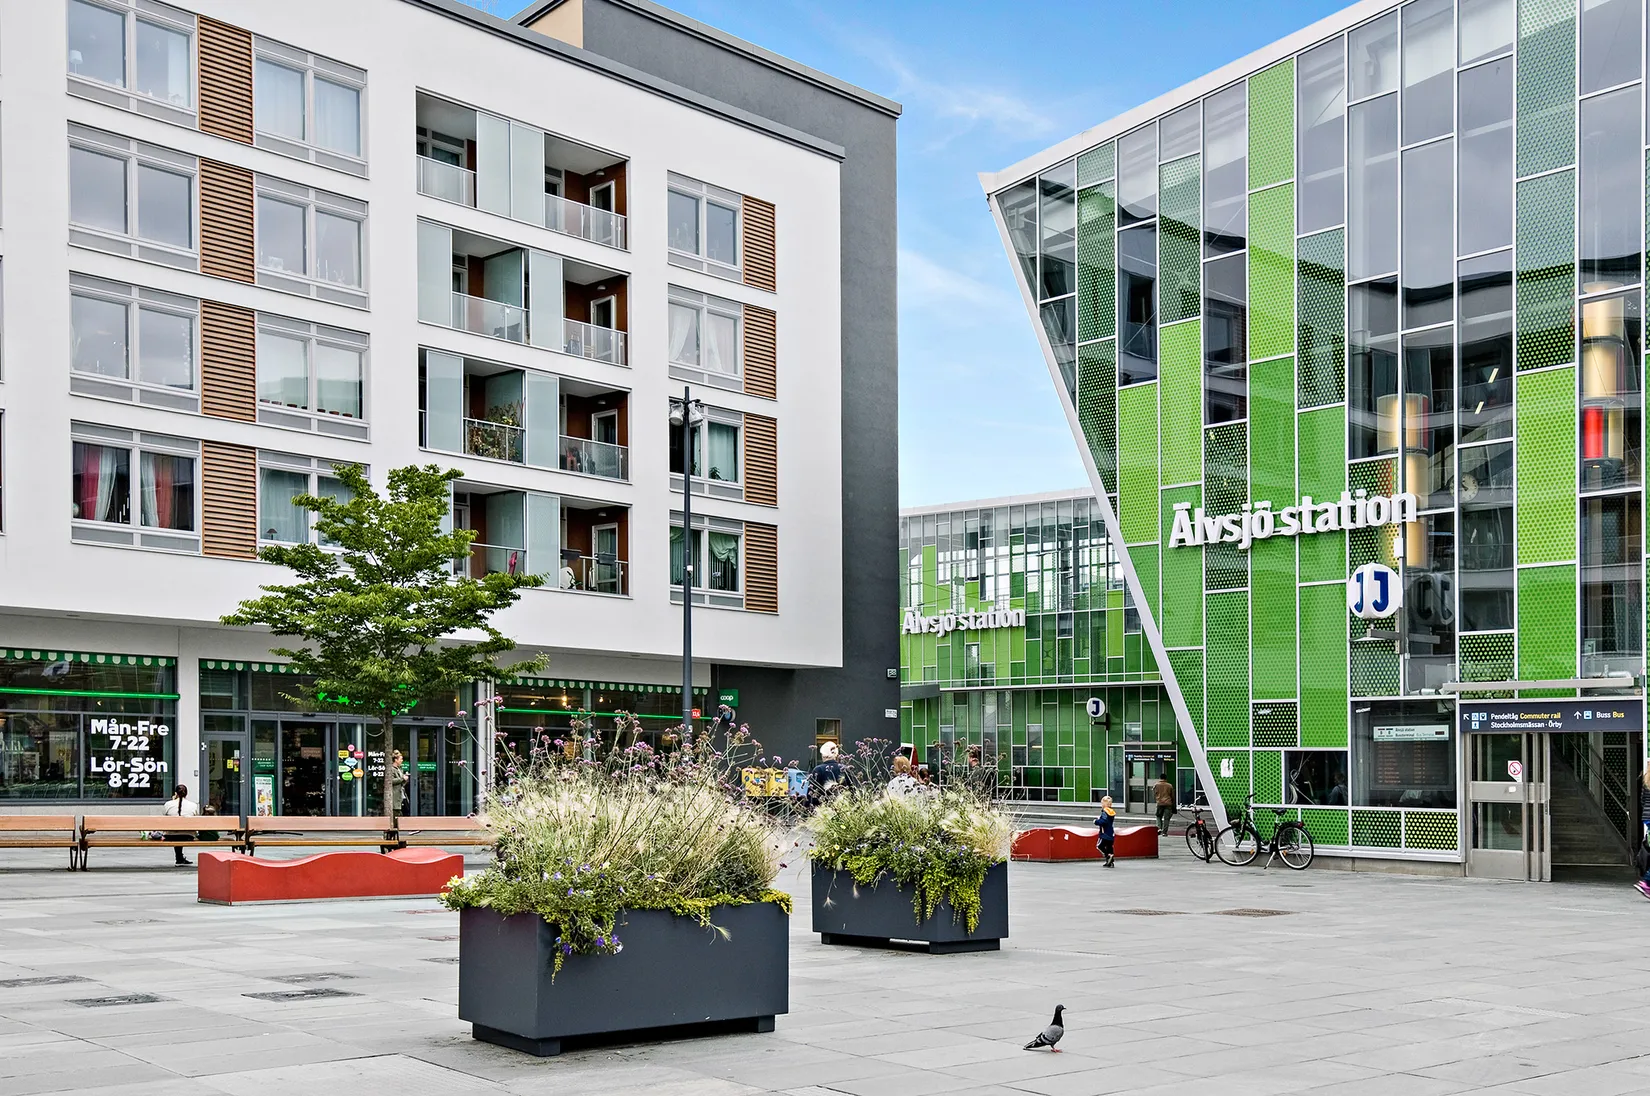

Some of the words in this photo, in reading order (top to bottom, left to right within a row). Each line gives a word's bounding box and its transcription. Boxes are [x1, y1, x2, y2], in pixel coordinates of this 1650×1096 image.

[1168, 500, 1274, 549] Älvsjö
[1280, 489, 1418, 536] station
[1372, 570, 1390, 613] J
[902, 607, 956, 637] Älvsjö
[955, 605, 1026, 631] station
[1091, 700, 1100, 715] J
[1490, 713, 1519, 721] Pendeltåg
[1519, 712, 1551, 720] Commuter
[90, 718, 169, 736] Mån-Fre
[1490, 721, 1545, 729] Stockholmsmässan
[1548, 720, 1563, 729] Örby
[110, 736, 150, 751] 7-22
[90, 757, 168, 772] Lör-Sön
[108, 773, 151, 788] 8-22
